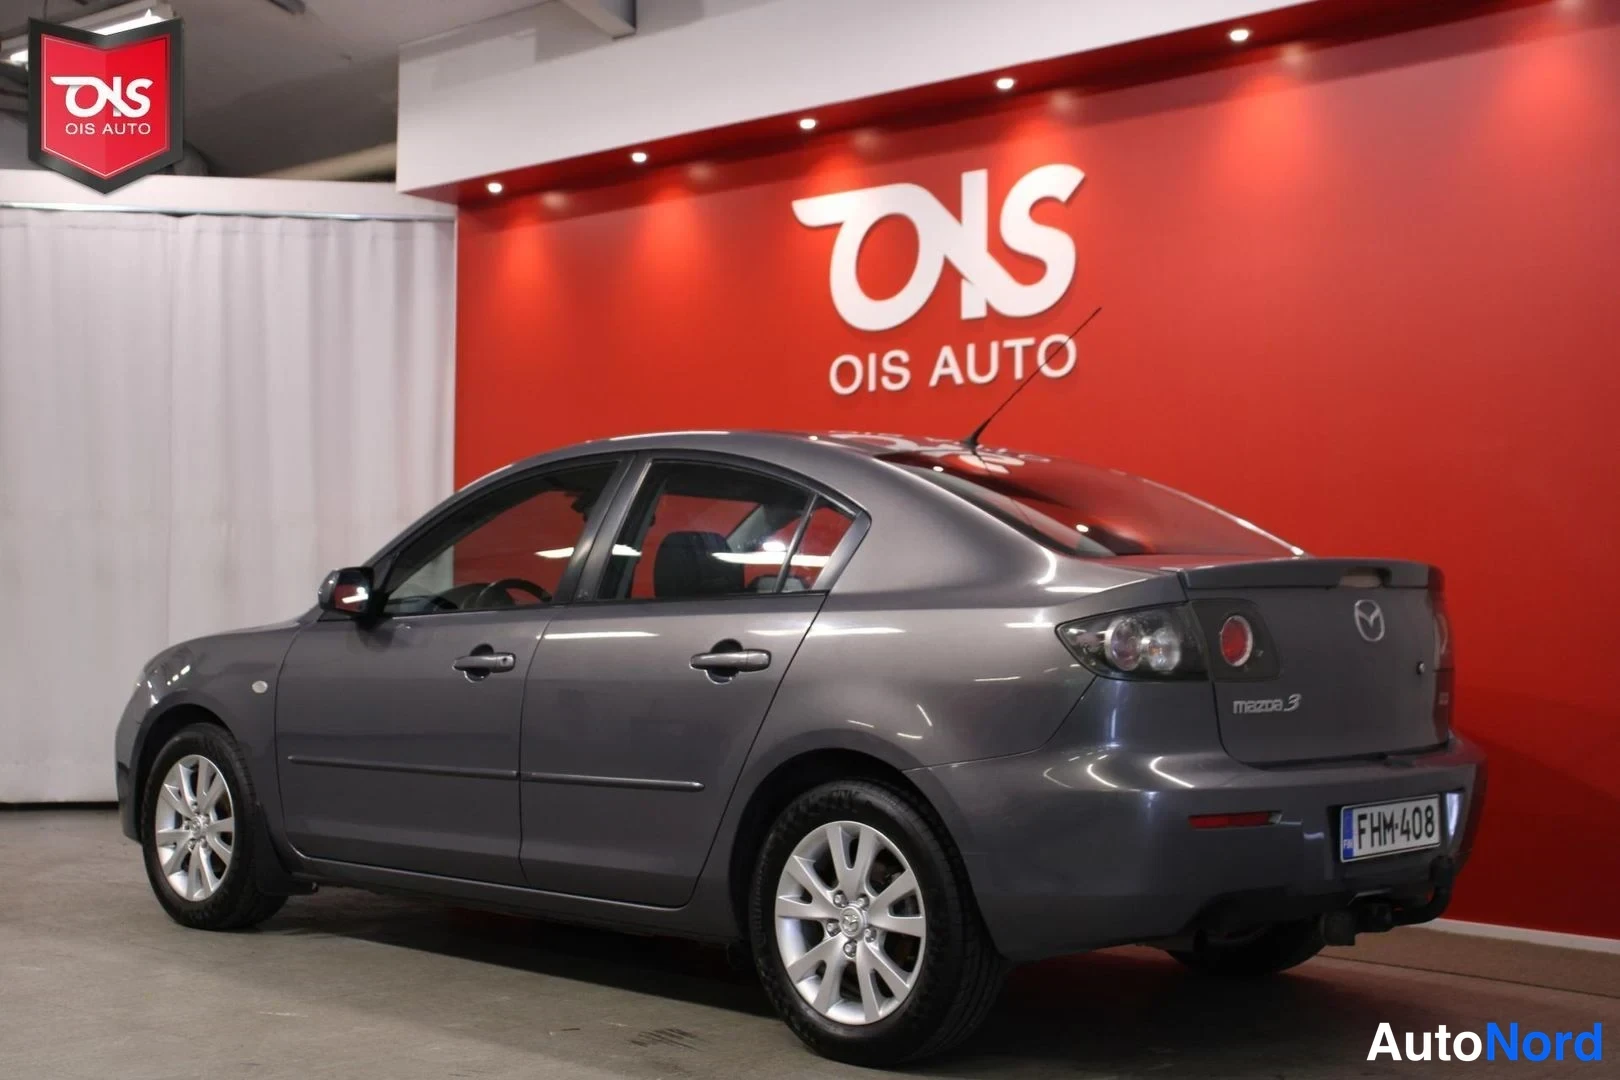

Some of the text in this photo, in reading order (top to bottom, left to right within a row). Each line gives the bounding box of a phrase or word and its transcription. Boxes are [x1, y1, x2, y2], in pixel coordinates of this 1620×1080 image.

[829, 334, 1077, 395] OIS AUTO
[1357, 805, 1435, 850] FHM-408
